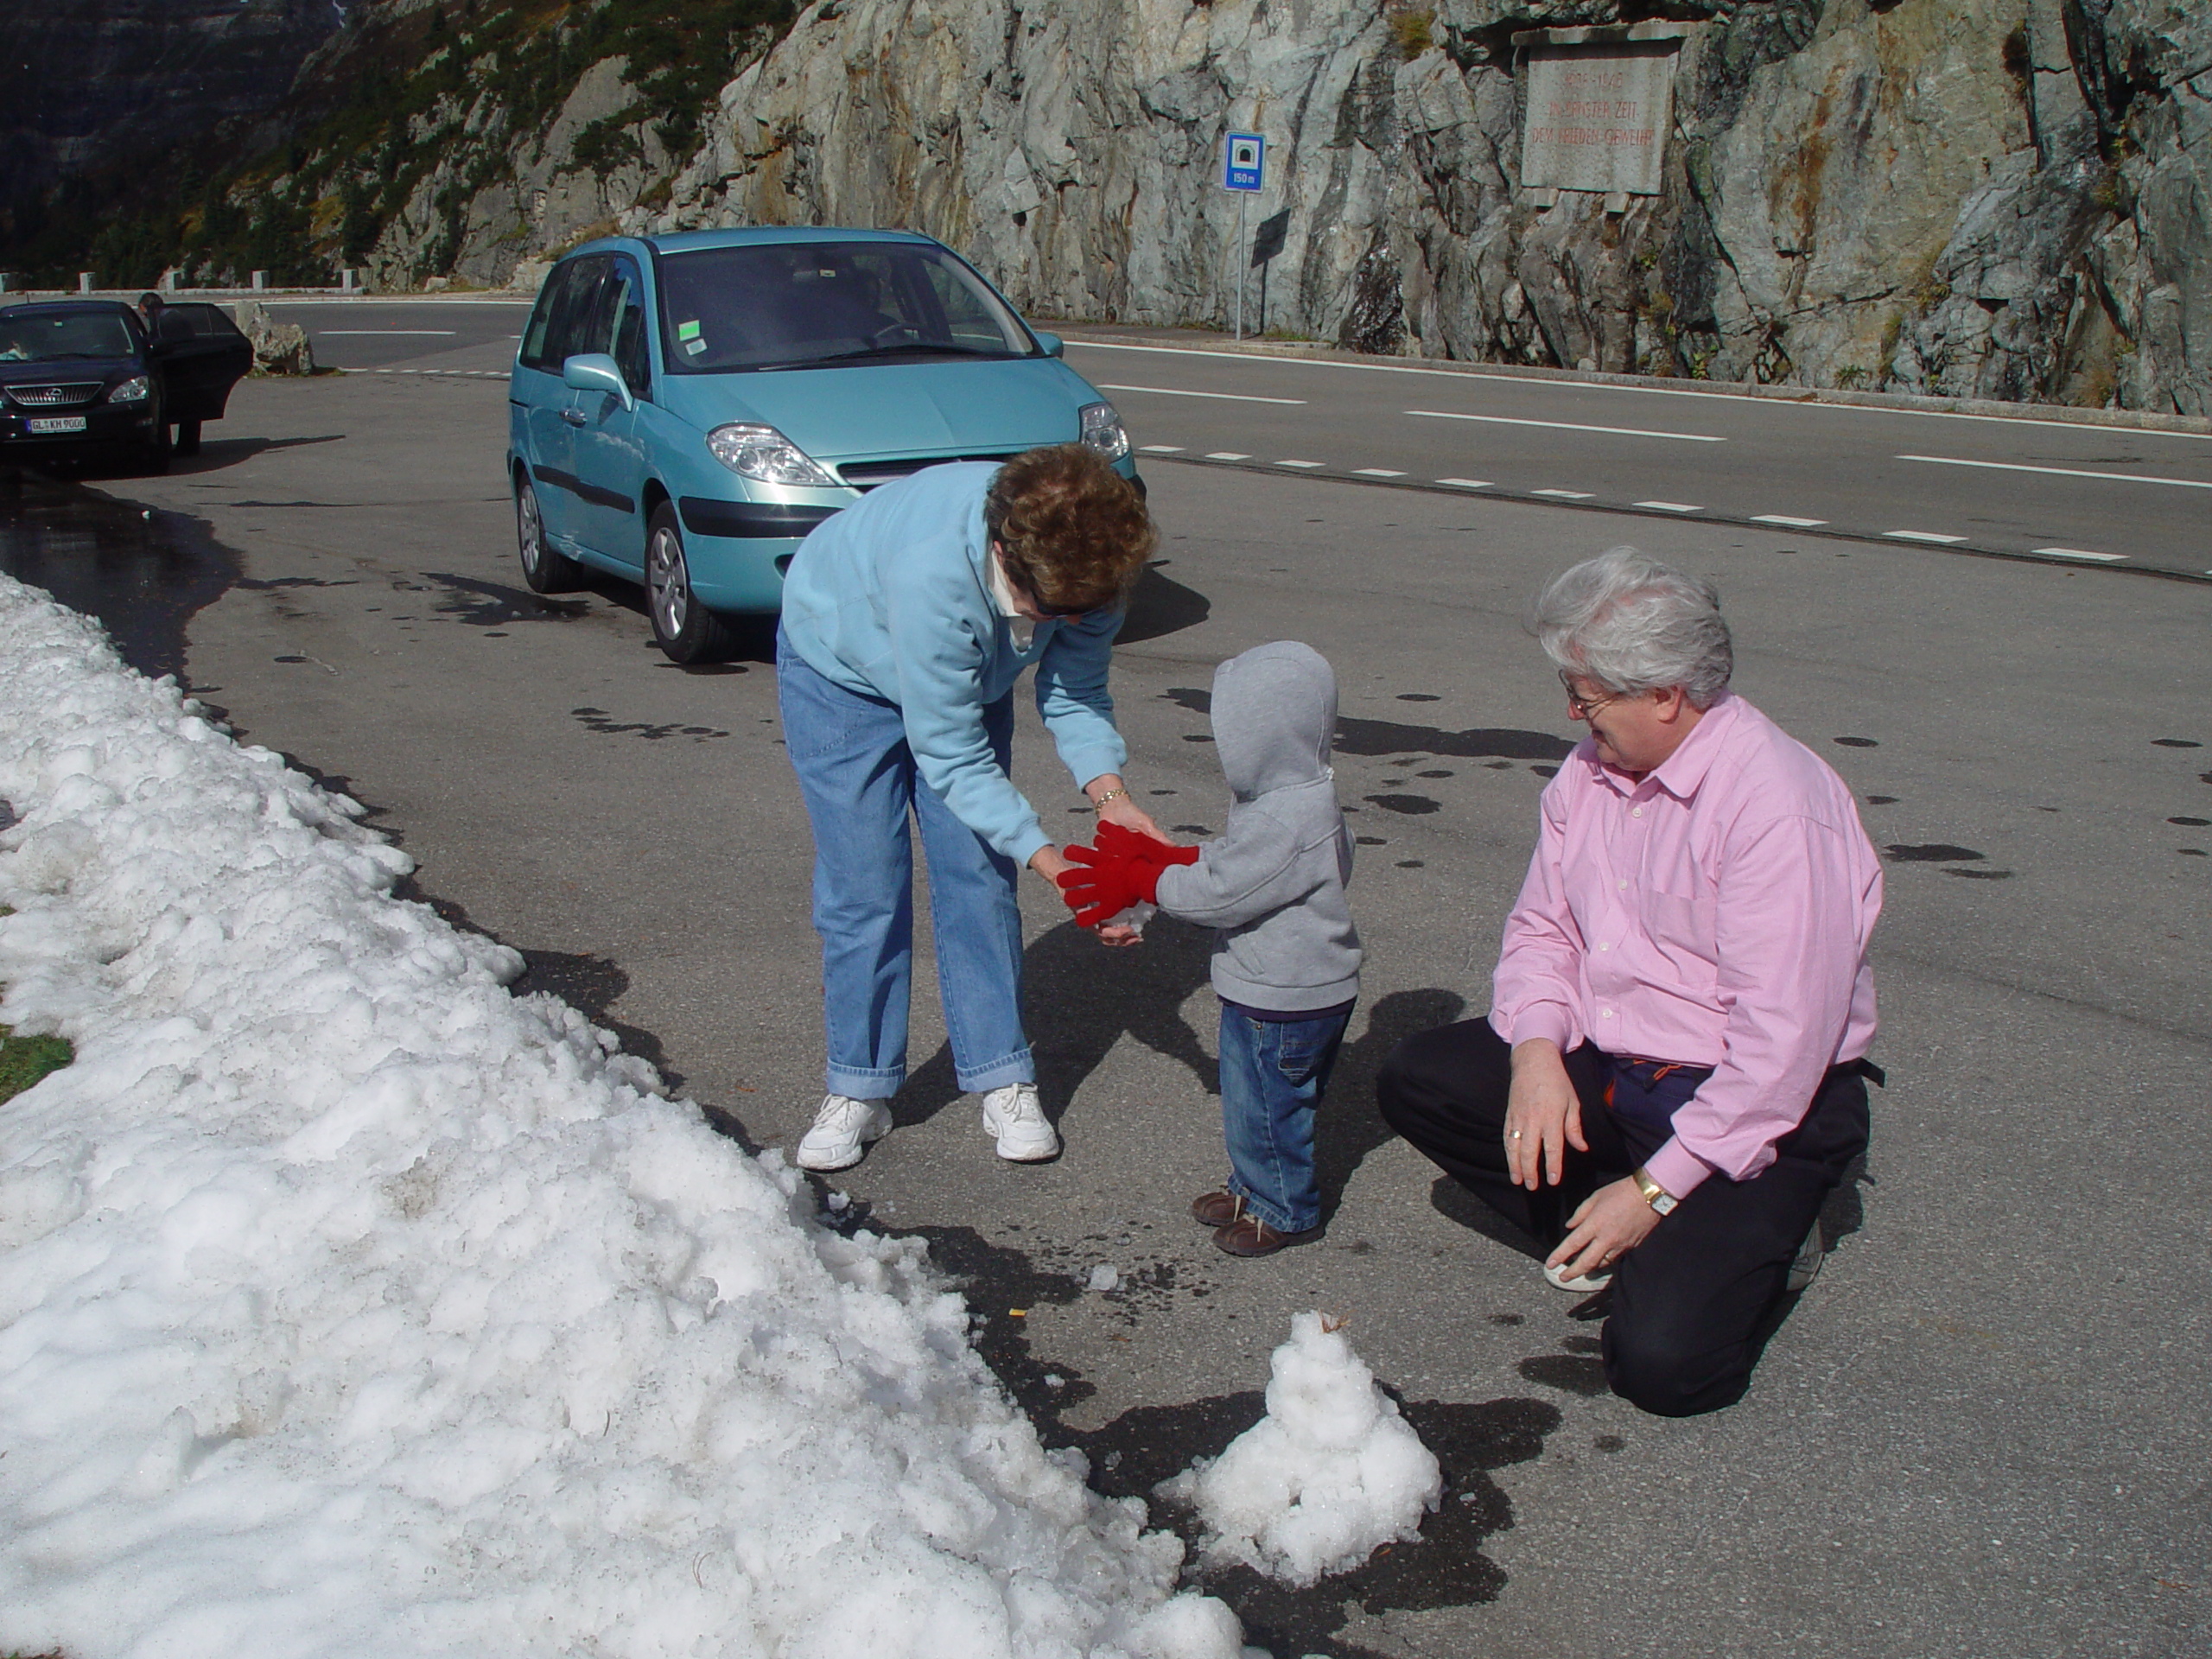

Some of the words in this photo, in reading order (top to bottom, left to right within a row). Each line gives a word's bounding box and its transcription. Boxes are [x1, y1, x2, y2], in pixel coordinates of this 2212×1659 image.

[1615, 101, 1638, 119] ZEIT
[1532, 127, 1554, 144] DEM
[50, 419, 62, 429] KH
